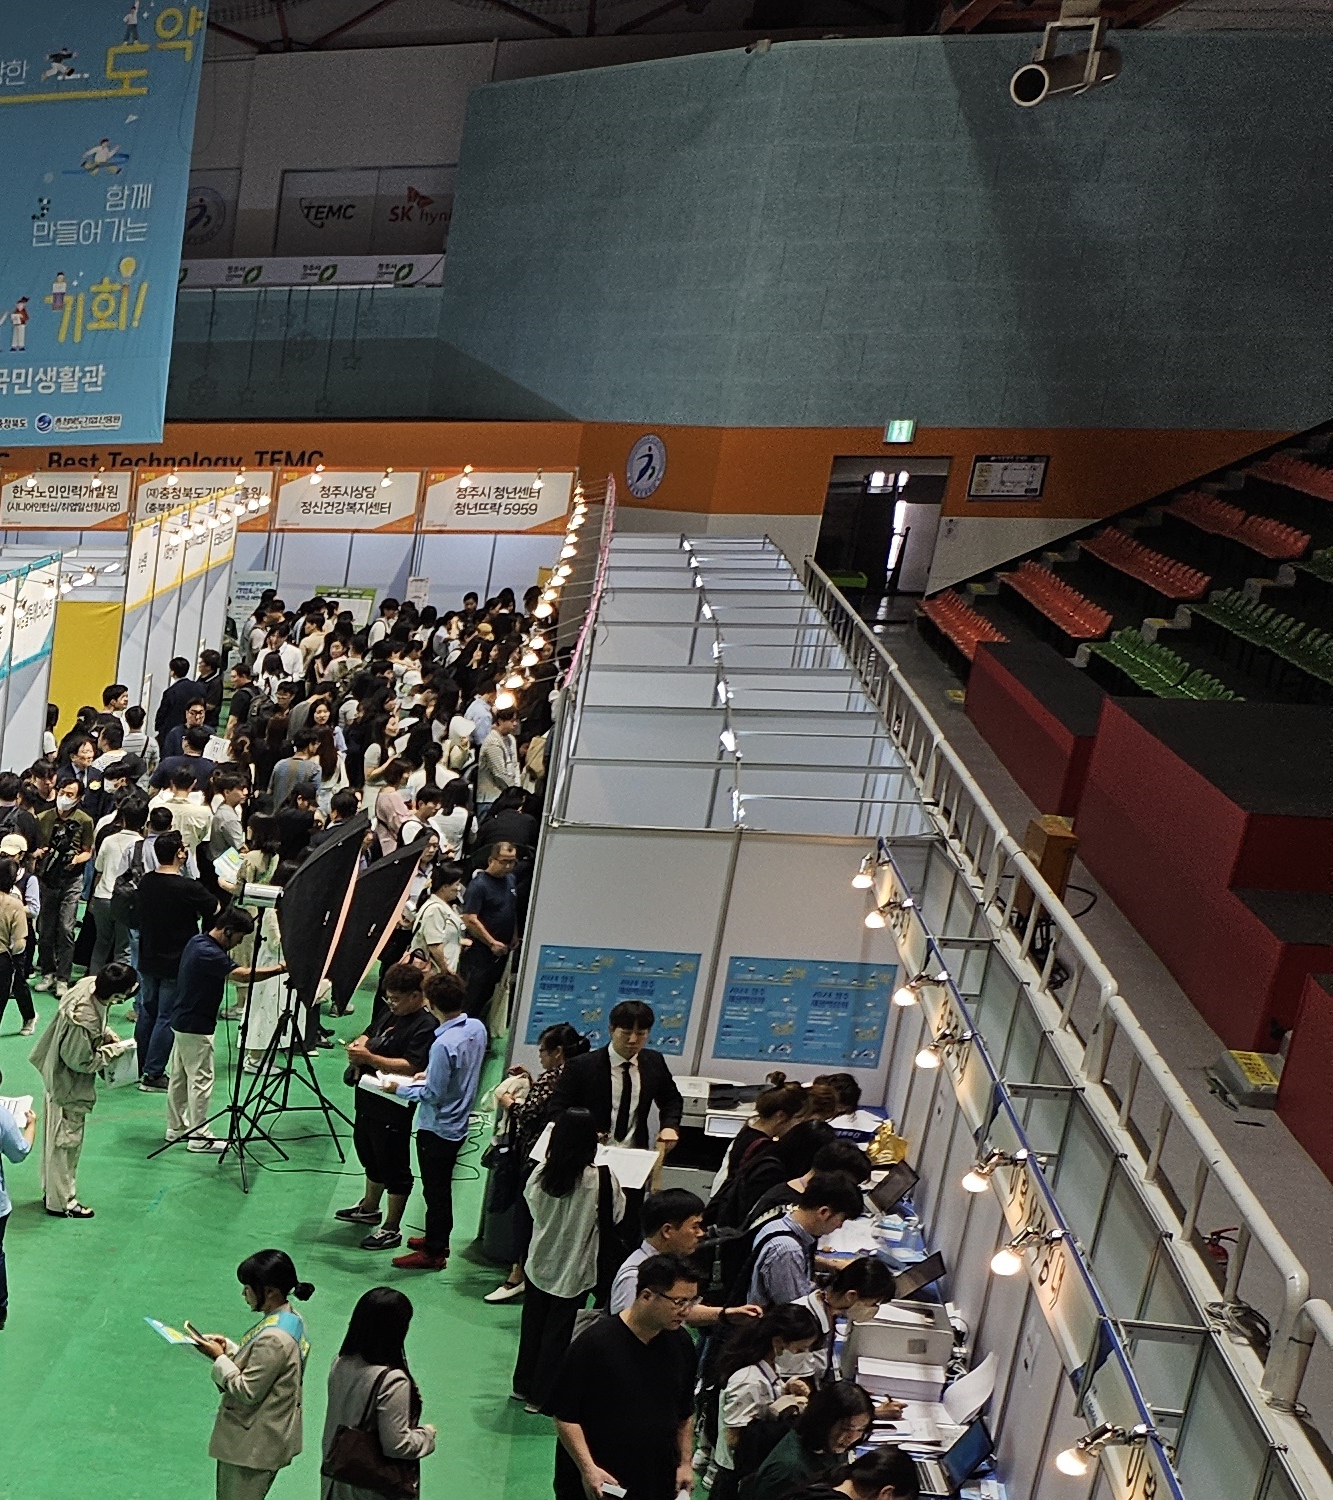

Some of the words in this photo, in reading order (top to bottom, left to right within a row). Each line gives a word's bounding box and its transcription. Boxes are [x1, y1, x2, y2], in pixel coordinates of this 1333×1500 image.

[105, 6, 204, 96] 도약
[106, 184, 152, 211] 함께
[303, 203, 356, 222] TEMC
[389, 205, 412, 222] SK
[48, 451, 100, 467] Best
[110, 451, 243, 468] Technology
[12, 484, 119, 499] 한국노인인력개발원
[319, 485, 377, 499] 청주시상당
[455, 486, 491, 499] 청주시
[493, 486, 541, 499] 청년센터
[300, 501, 392, 515] 정신건강복지센터
[502, 502, 538, 515] 5959
